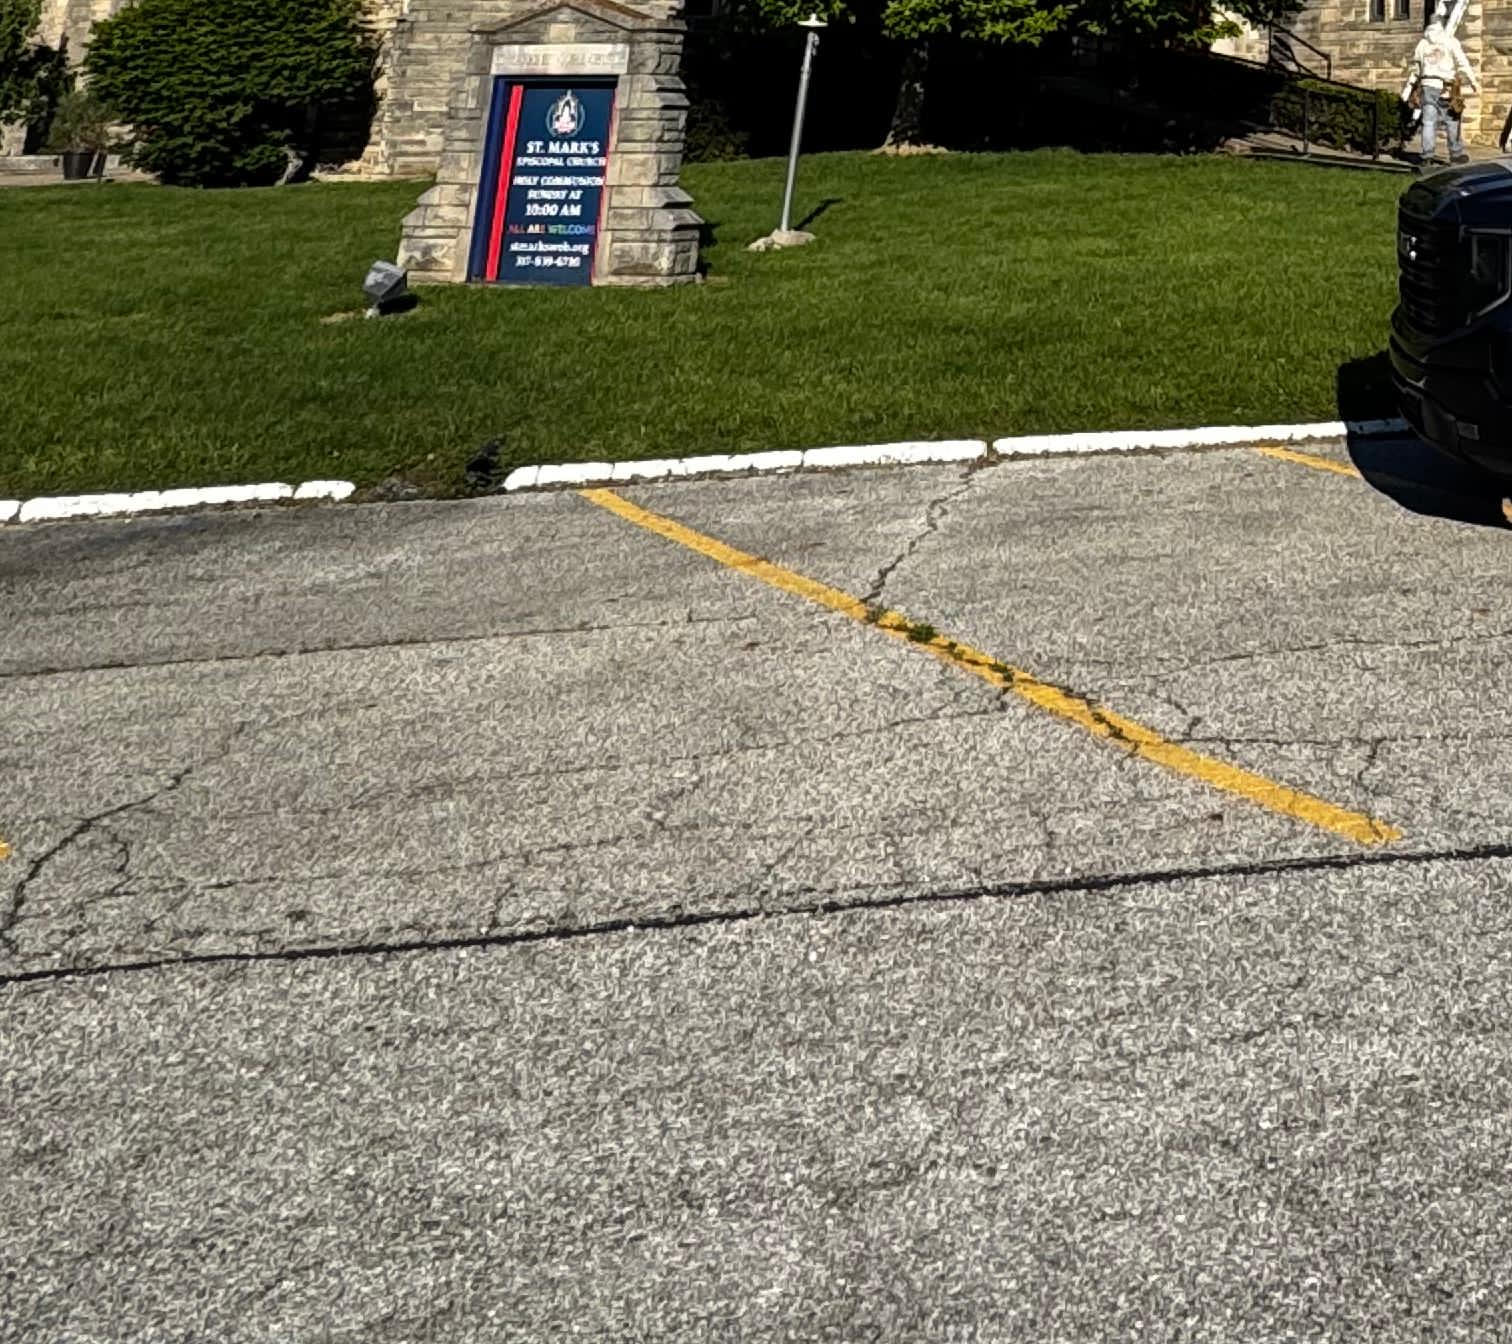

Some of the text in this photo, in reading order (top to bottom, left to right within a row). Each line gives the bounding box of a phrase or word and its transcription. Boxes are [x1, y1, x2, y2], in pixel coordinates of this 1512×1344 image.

[526, 141, 600, 154] ST. MARK'S
[566, 156, 606, 167] CHURCH
[527, 190, 583, 200] SUNDAY AT
[525, 204, 581, 216] 10:00 AM
[527, 224, 545, 234] ARE
[547, 224, 595, 235] WELCOME
